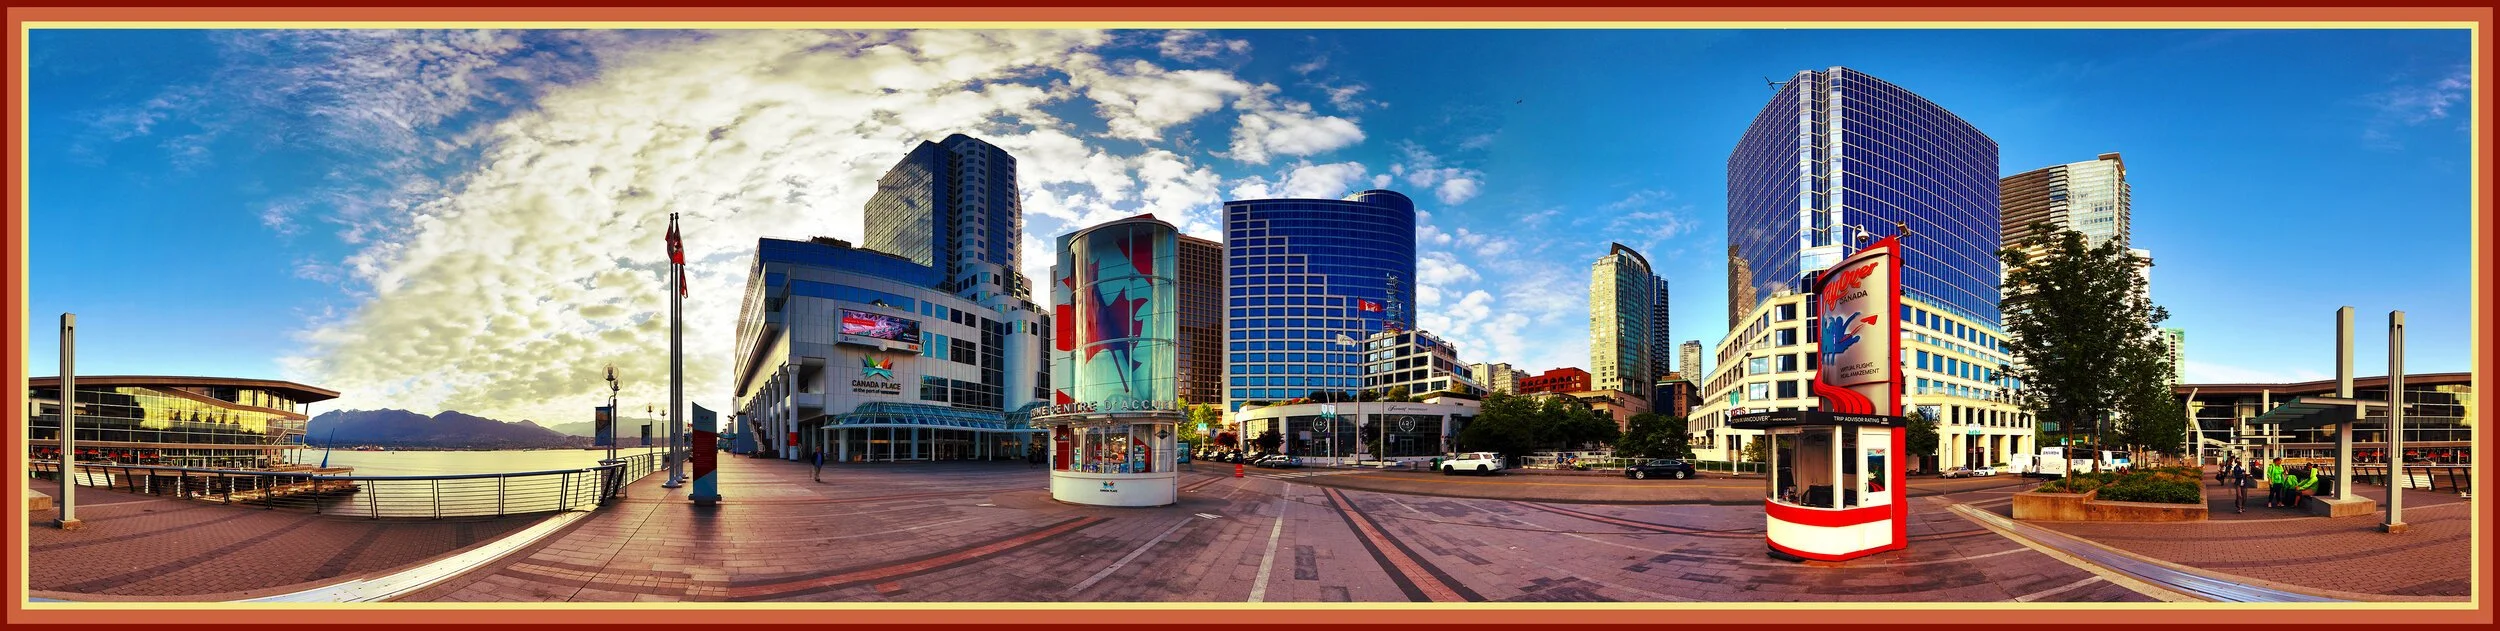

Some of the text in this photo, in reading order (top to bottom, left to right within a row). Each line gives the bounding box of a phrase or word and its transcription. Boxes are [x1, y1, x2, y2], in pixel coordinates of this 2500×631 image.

[1822, 262, 1879, 316] FlyOver
[1840, 290, 1868, 305] CANADA
[1850, 368, 1880, 377] AMAZEMENT
[852, 380, 901, 390] CANADA PLACE
[1050, 401, 1098, 414] CENTRE
